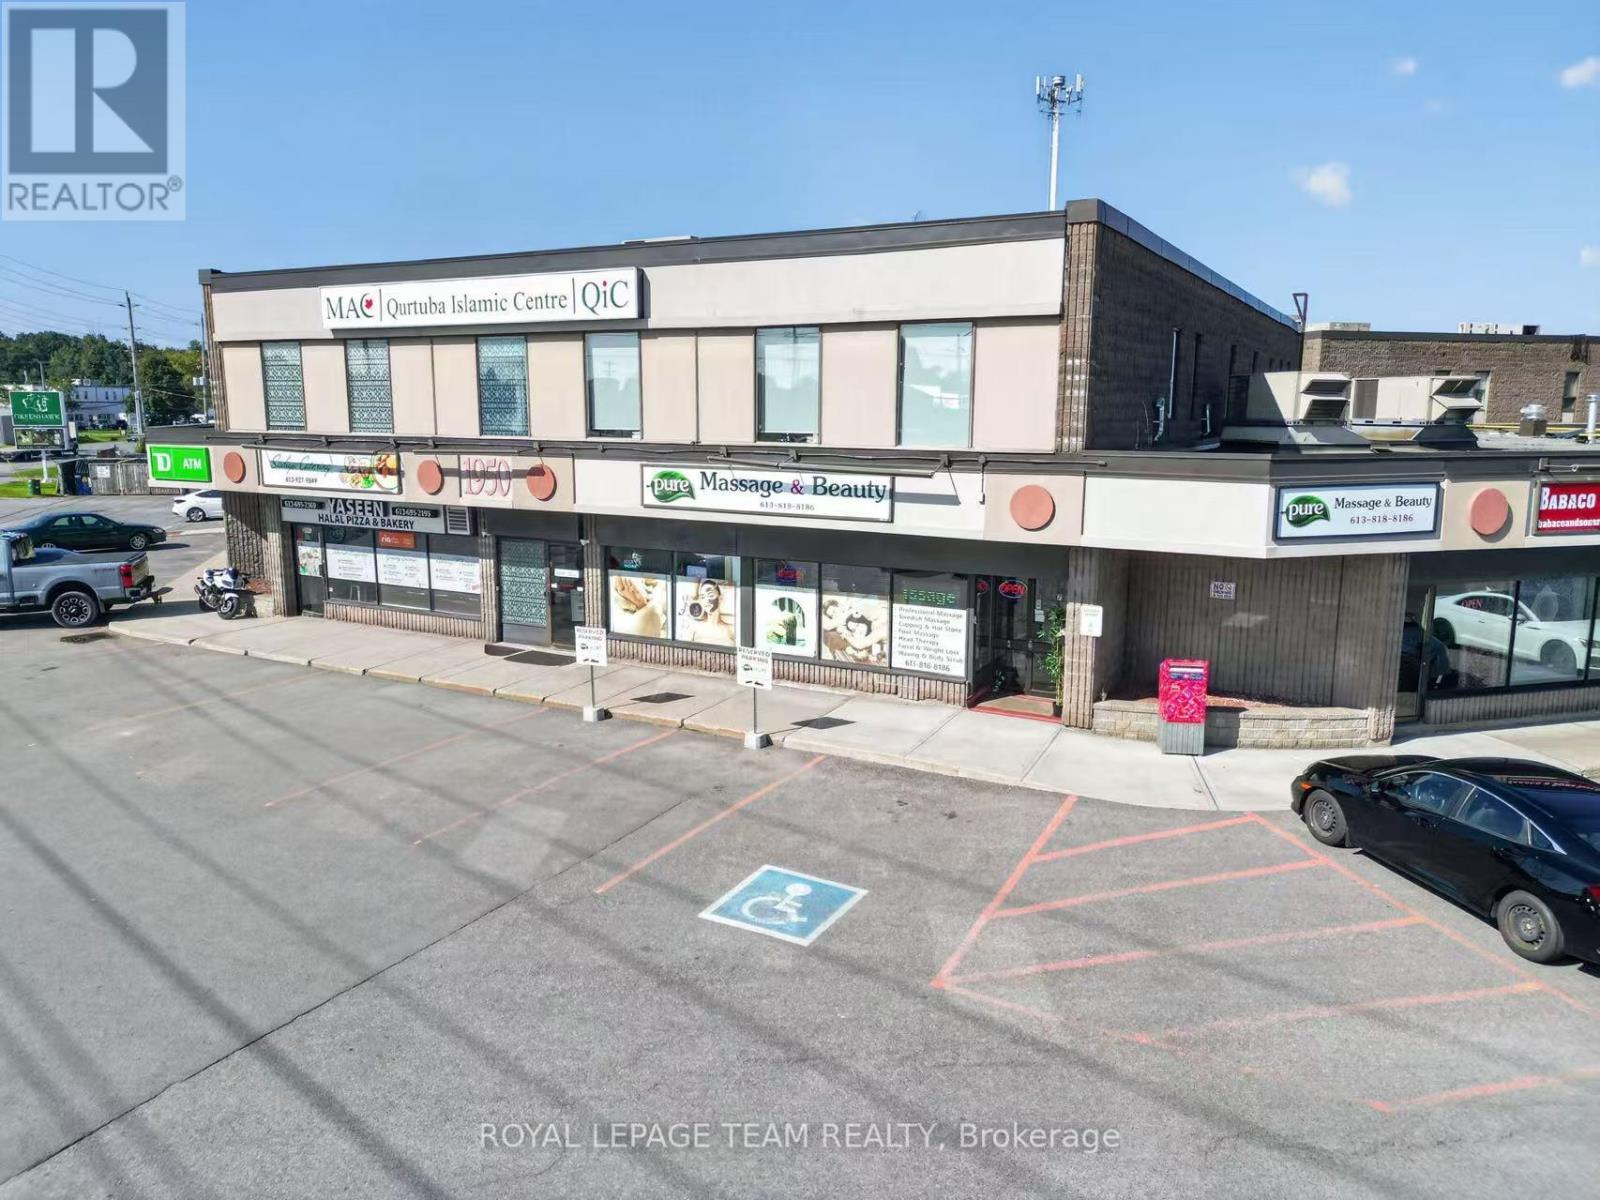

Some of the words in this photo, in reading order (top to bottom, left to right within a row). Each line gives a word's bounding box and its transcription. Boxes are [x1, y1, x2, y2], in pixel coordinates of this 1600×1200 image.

[386, 296, 446, 320] Qurtuba
[451, 291, 509, 314] Islamic
[513, 290, 568, 312] Centre
[581, 279, 630, 315] QiC
[153, 452, 171, 472] TD
[182, 457, 202, 471] ATM
[463, 457, 512, 497] 1950
[653, 476, 690, 493] pure
[699, 471, 784, 498] Massage
[790, 478, 805, 495] &
[812, 475, 888, 504] Beauty
[327, 498, 384, 517] YASEEN
[1288, 502, 1324, 521] pure
[1333, 497, 1382, 511] Massage
[1384, 498, 1392, 508] &
[1395, 495, 1433, 509] Beauty
[1539, 486, 1597, 511] BABACO
[318, 513, 345, 525] HALAL
[346, 515, 371, 527] PIZZA
[372, 517, 380, 528] &
[380, 518, 415, 531] BAKERY
[1350, 514, 1414, 525] 613-818-8186
[1001, 583, 1025, 595] OPEN
[1461, 598, 1484, 609] OPEN
[738, 647, 771, 658] RESERVED
